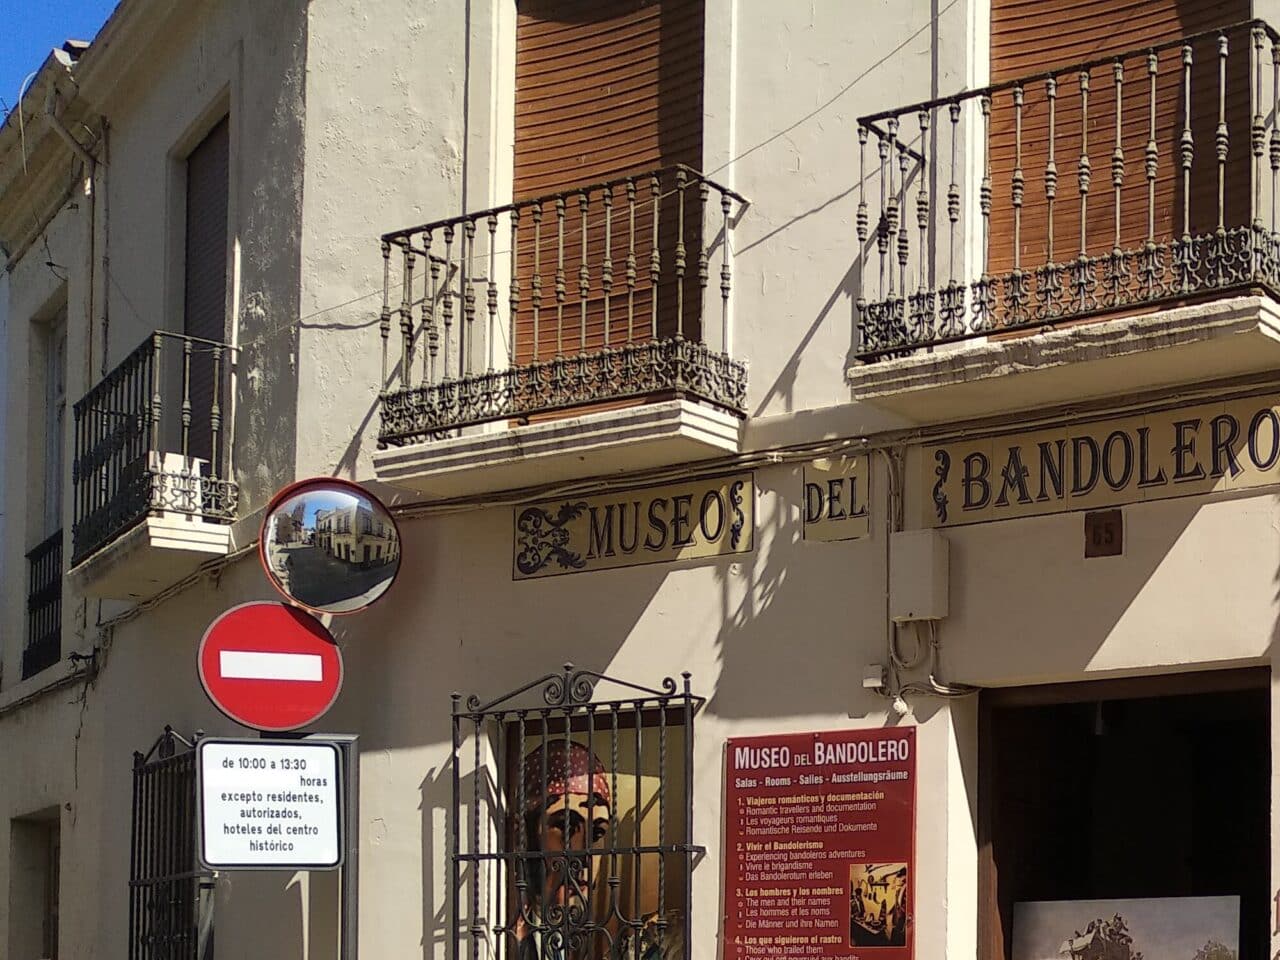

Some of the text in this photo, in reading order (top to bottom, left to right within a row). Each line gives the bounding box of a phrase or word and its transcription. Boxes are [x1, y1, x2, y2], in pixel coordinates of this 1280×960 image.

[586, 488, 724, 559] MUSEO
[805, 476, 869, 524] DEL
[735, 739, 909, 770] MUSEO DEL BANDOLERO
[222, 757, 307, 770] de 10:00 a 13:30
[300, 775, 328, 787] horas
[735, 778, 757, 788] Salas
[765, 776, 791, 786] Rooms
[799, 774, 823, 785] Salles
[831, 770, 908, 783] Ausstellungsräume
[221, 791, 324, 804] excepto residentes,
[746, 796, 777, 806] Viajeros
[778, 795, 819, 804] románticos
[820, 795, 825, 803] y
[827, 791, 884, 801] documentación
[240, 807, 302, 820] autorizados,
[746, 802, 877, 815] Romantic travellers and documentation
[746, 814, 838, 826] Les voyageurs romantiques
[223, 823, 319, 835] hoteles del centro
[746, 822, 878, 835] Romantische Reisende und Dokumente
[250, 839, 294, 851] histórico
[746, 842, 763, 851] Vivir
[765, 842, 772, 850] el
[774, 841, 823, 850] Bandolerismo
[746, 850, 865, 861] Experiencing bandoleros adventures
[746, 862, 812, 871] Vivre le brigandisme
[746, 872, 758, 881] Das
[809, 871, 833, 879] erleben
[746, 888, 758, 896] Los
[760, 888, 791, 896] hombres
[793, 889, 797, 897] y
[799, 887, 810, 895] los
[812, 887, 843, 895] nombres
[746, 898, 758, 906] The
[777, 898, 789, 906] and
[791, 898, 805, 906] their
[746, 908, 758, 916] Les
[760, 908, 789, 916] hommes
[746, 920, 756, 928] Die
[759, 919, 784, 928] Männer
[815, 919, 838, 927] Namen
[745, 936, 757, 944] Los
[759, 937, 772, 945] que
[775, 935, 809, 945] siguieron
[811, 935, 817, 943] el
[746, 946, 765, 954] Those
[784, 945, 804, 953] trailed
[806, 945, 823, 953] them
